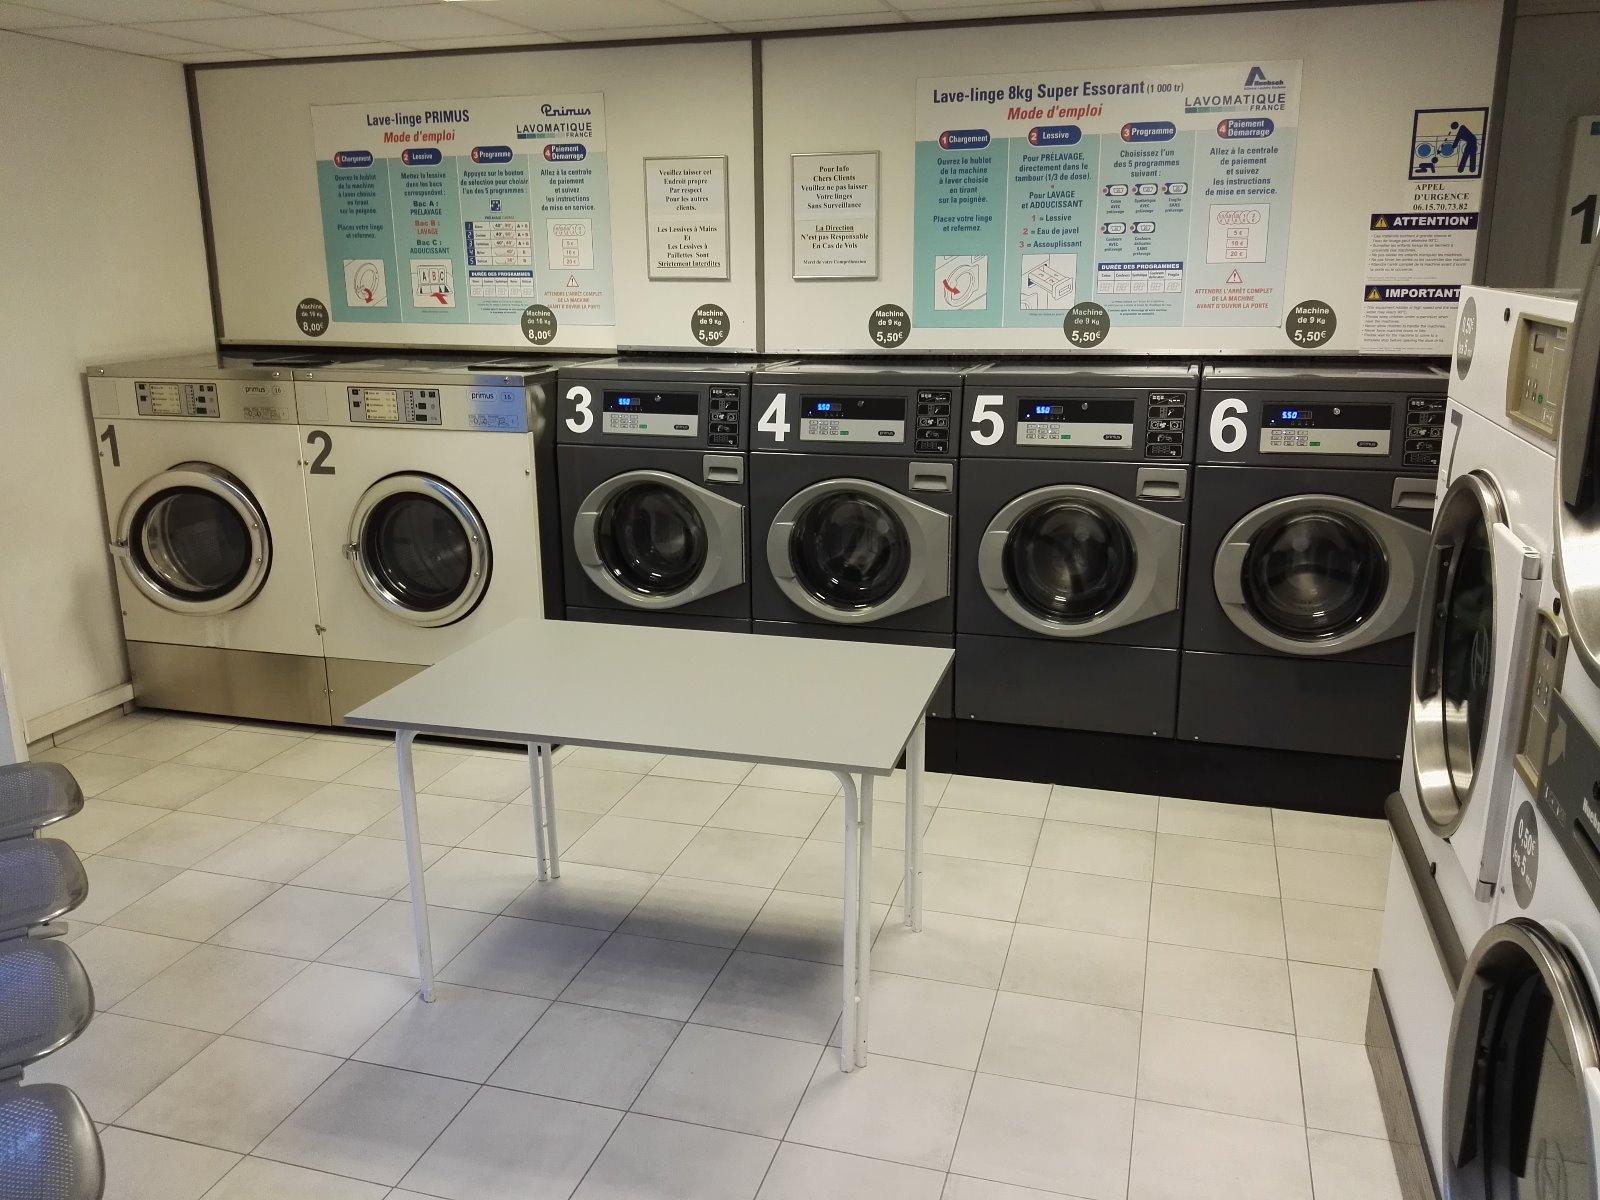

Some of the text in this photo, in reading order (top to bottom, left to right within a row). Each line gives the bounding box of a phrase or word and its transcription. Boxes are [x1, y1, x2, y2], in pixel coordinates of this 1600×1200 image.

[933, 87, 1005, 104] Lave-linge
[1008, 85, 1033, 101] 8kg
[1037, 83, 1079, 101] Super
[1083, 81, 1145, 96] Essorant
[1156, 83, 1172, 93] 000
[1174, 82, 1184, 93] tr)
[1185, 93, 1286, 107] LAVOMATIQUE
[1007, 103, 1103, 120] Mode d'emploi
[366, 109, 470, 127] Lave-linge PRIMUS
[516, 122, 592, 134] LAVOMATIQUE
[1219, 119, 1265, 133] 4 Paiement
[383, 129, 456, 144] Mode d'emploi
[1031, 131, 1070, 141] 2 Lessive
[1123, 127, 1174, 138] 3 Programme
[1228, 127, 1270, 137] Démarrage
[941, 134, 988, 145] 1 Chargement
[473, 150, 511, 160] 3 Programme
[545, 144, 579, 157] 4 Paiement
[1119, 148, 1175, 157] Choisissez l'un
[1022, 154, 1039, 162] Pour
[1019, 162, 1089, 172] directement dans le
[1113, 160, 1180, 169] des 5 programmes
[833, 174, 856, 182] Clients
[1015, 174, 1043, 182] tambour
[1059, 173, 1069, 181] de
[1070, 172, 1092, 182] dose).
[1415, 183, 1445, 191] APPEL
[1029, 190, 1075, 199] Pour LAVAGE
[1414, 192, 1470, 201] D'URGENCE
[1029, 200, 1083, 209] ADOUCISSANT
[1412, 203, 1468, 211] 06.15.70.73.82
[1571, 194, 1597, 244] 1
[830, 233, 869, 241] Responsable
[1295, 306, 1330, 315] Machine
[1074, 317, 1084, 325] de
[1085, 317, 1090, 325] 9
[1298, 316, 1308, 324] de
[1309, 316, 1315, 324] 9
[698, 329, 724, 342] 5,50€
[876, 331, 903, 343] 5,50€
[1071, 330, 1101, 342] 5,50€
[1294, 329, 1327, 342] 5,50€
[244, 386, 266, 395] primus
[471, 392, 494, 401] primus
[565, 386, 594, 433] 3
[758, 393, 790, 442] 4
[970, 394, 1005, 446] 5
[1209, 398, 1249, 452] 6
[100, 424, 121, 467] 1
[307, 429, 336, 475] 2
